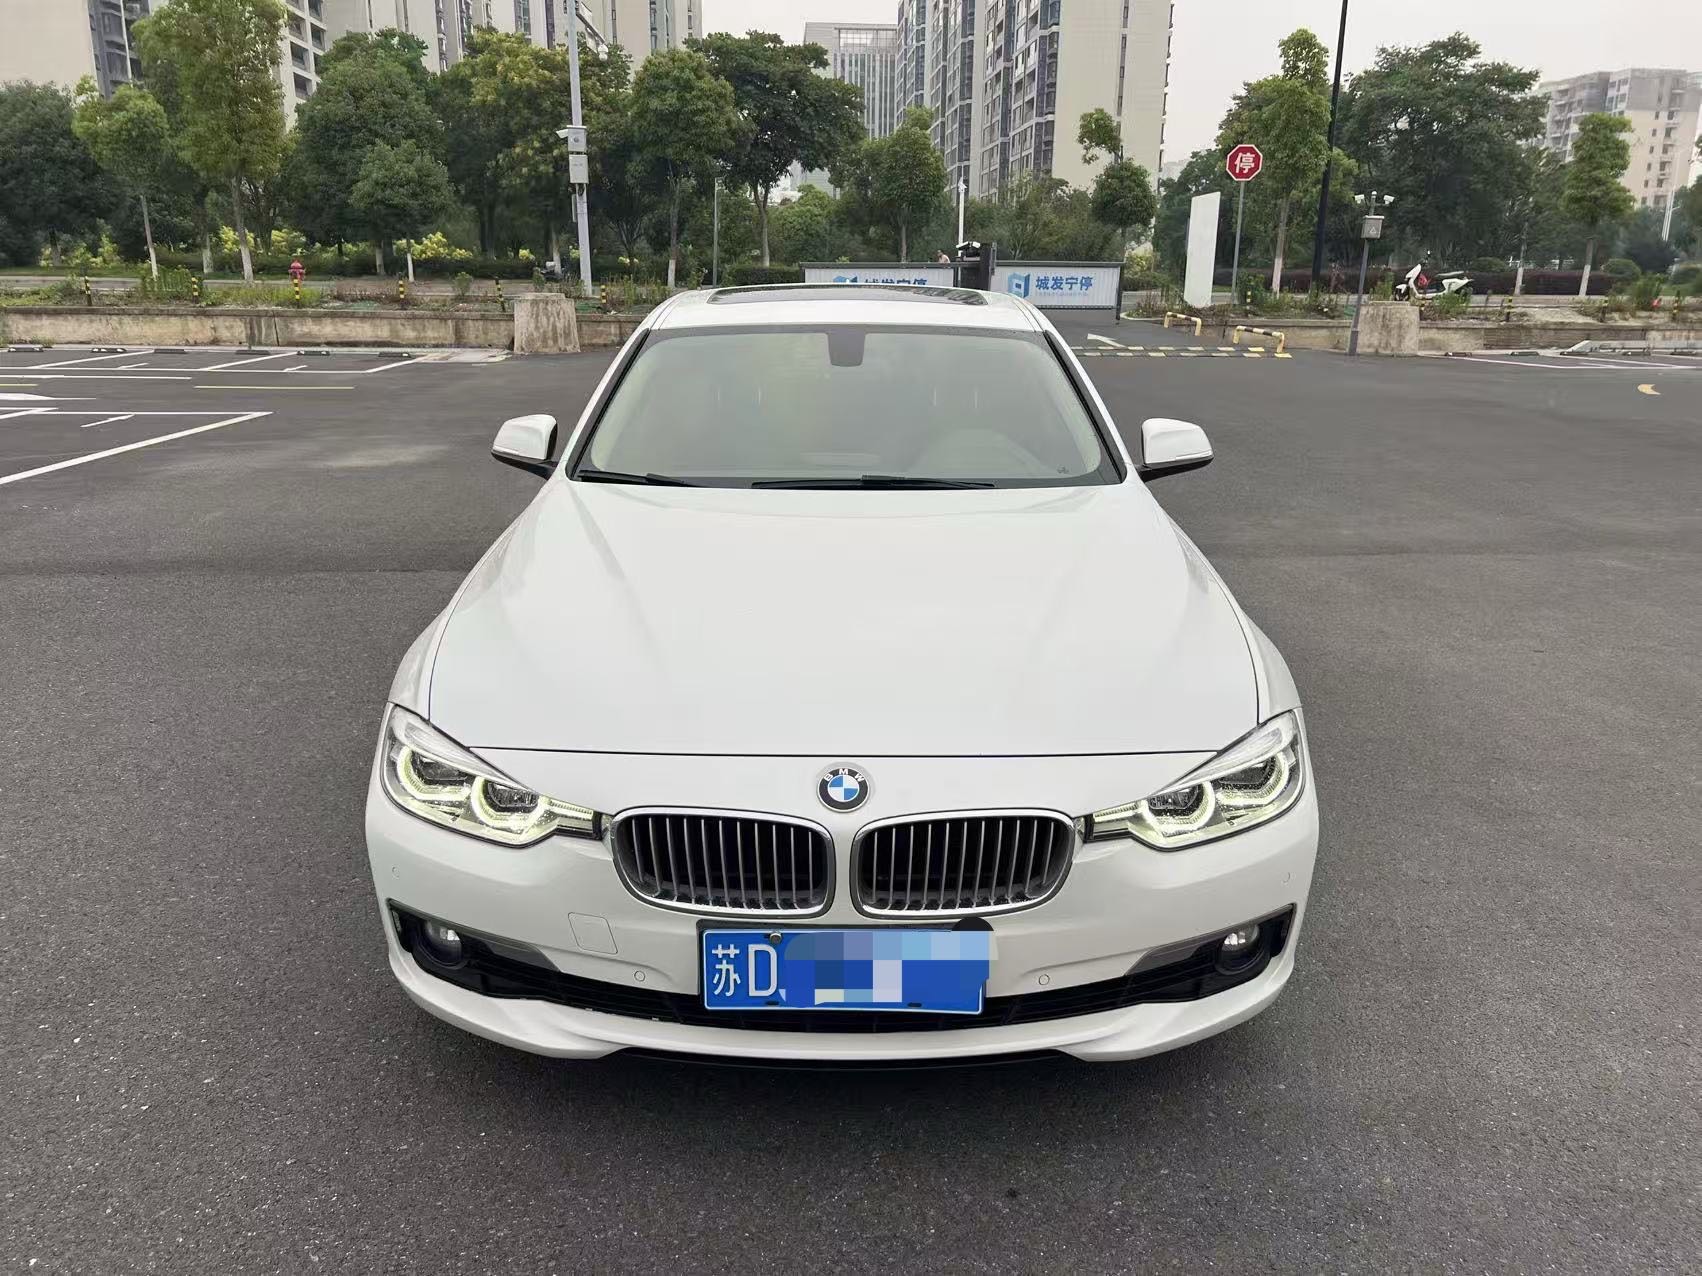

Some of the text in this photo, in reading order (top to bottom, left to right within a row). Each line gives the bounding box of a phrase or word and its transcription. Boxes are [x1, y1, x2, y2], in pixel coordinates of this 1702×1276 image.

[1234, 152, 1255, 173] 停
[1035, 276, 1093, 291] 城发宁停
[823, 768, 865, 782] BMW
